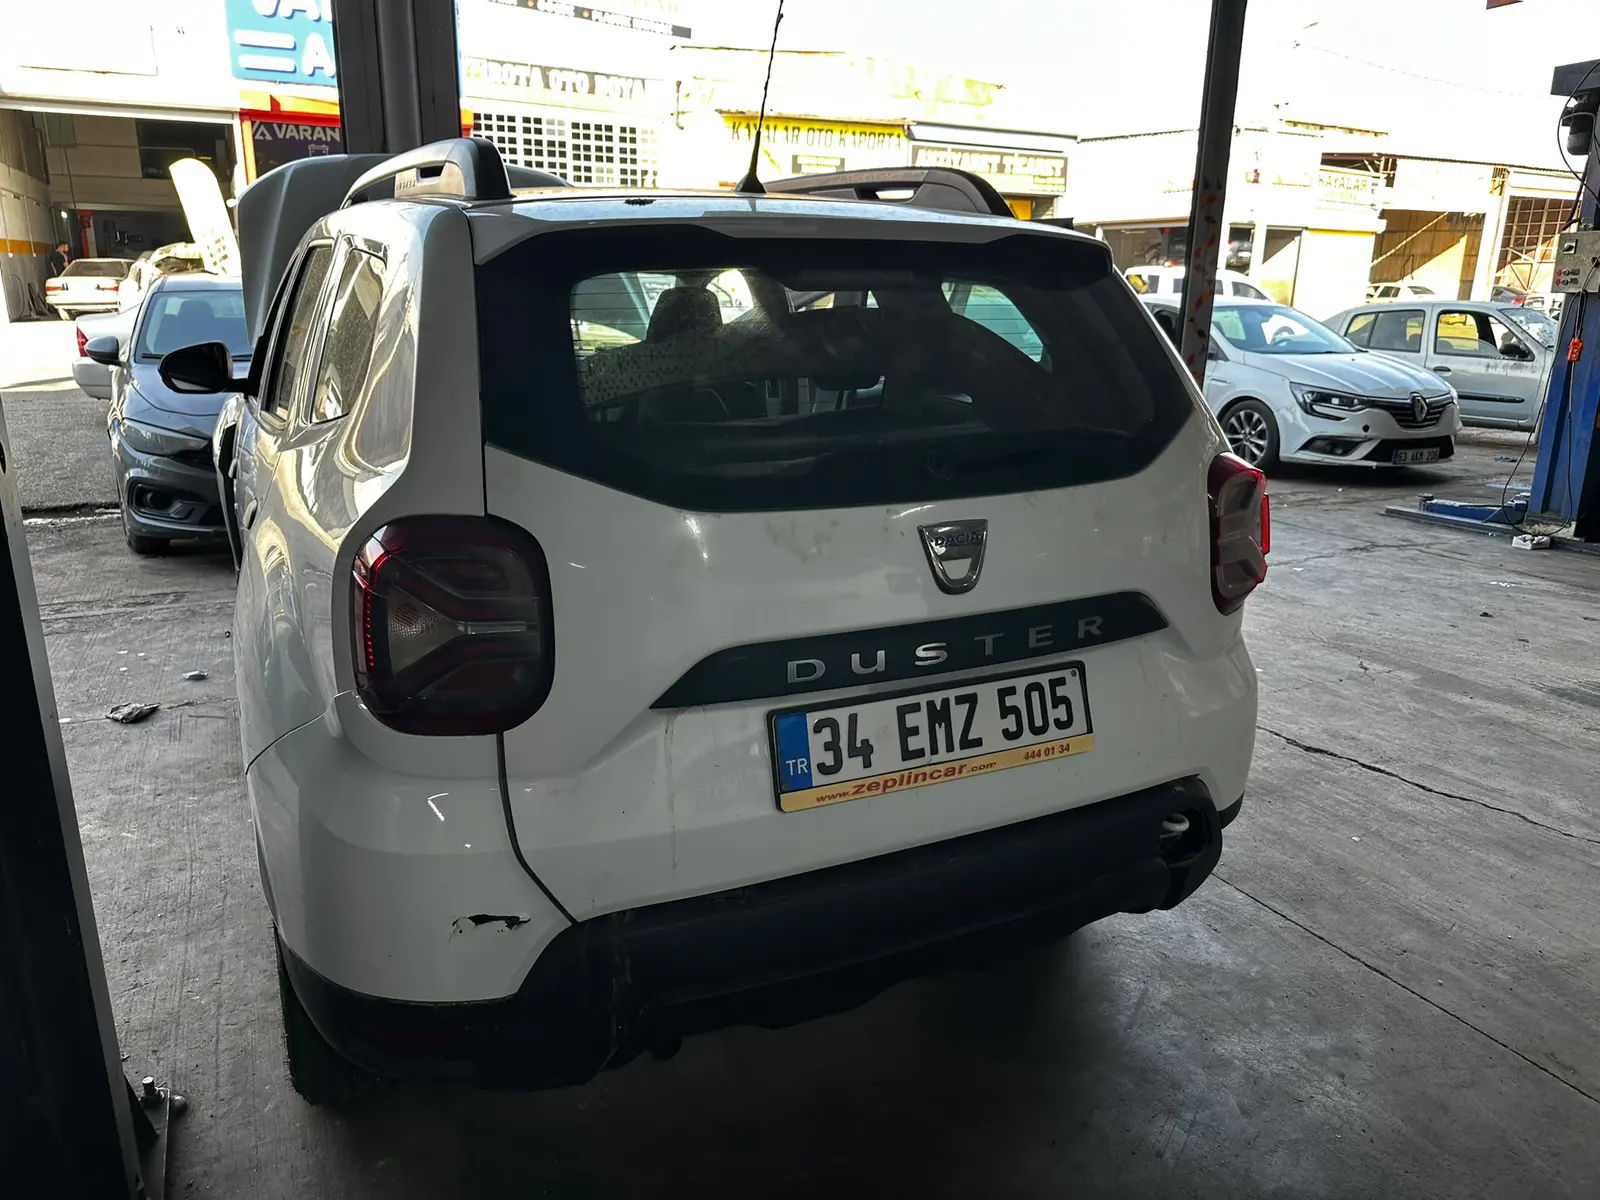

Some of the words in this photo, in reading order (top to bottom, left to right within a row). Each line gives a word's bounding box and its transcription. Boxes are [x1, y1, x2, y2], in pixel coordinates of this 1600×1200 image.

[806, 126, 834, 149] OTO
[839, 128, 902, 151] KAPORTA
[934, 531, 981, 548] DACIA
[786, 614, 1105, 684] DUSTER
[812, 712, 874, 776] 34
[896, 691, 984, 762] EMZ
[997, 676, 1074, 742] 505
[1023, 748, 1042, 761] 444
[1044, 745, 1056, 757] 01
[1058, 743, 1070, 754] 34
[786, 757, 809, 777] TR
[815, 760, 998, 804] www.zeplincar.com
